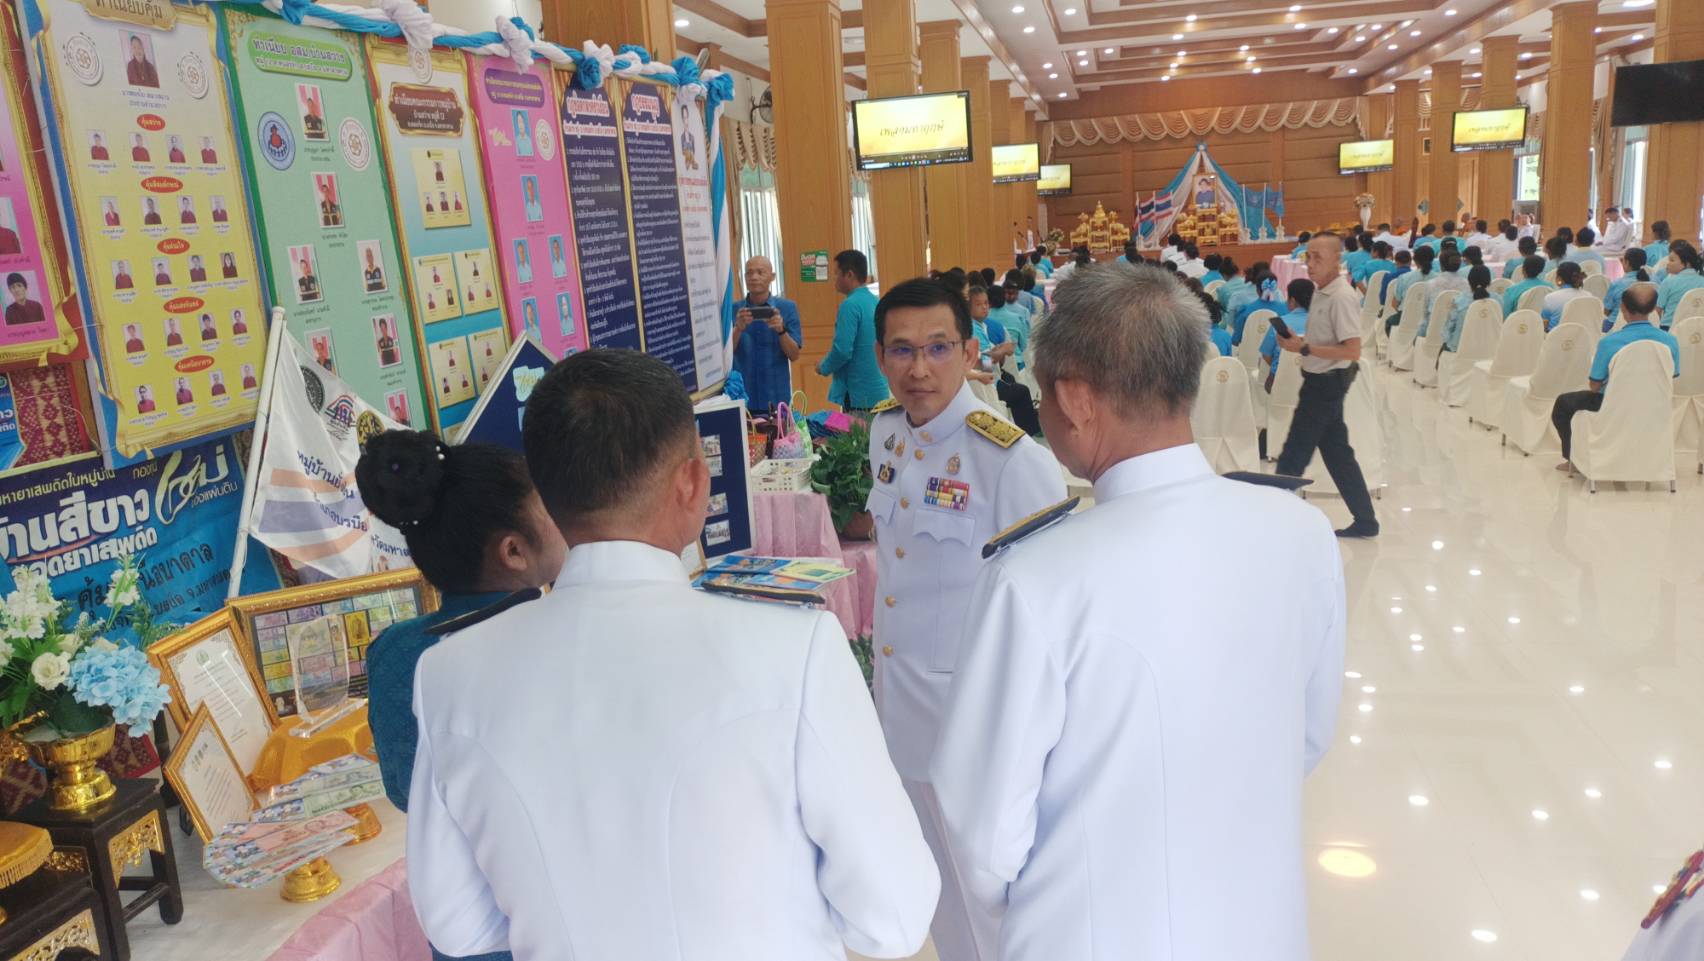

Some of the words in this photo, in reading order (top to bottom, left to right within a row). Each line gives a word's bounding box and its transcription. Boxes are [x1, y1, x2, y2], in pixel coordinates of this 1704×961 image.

[0, 467, 116, 506] หายาเสพติดในหมู่บ้าน
